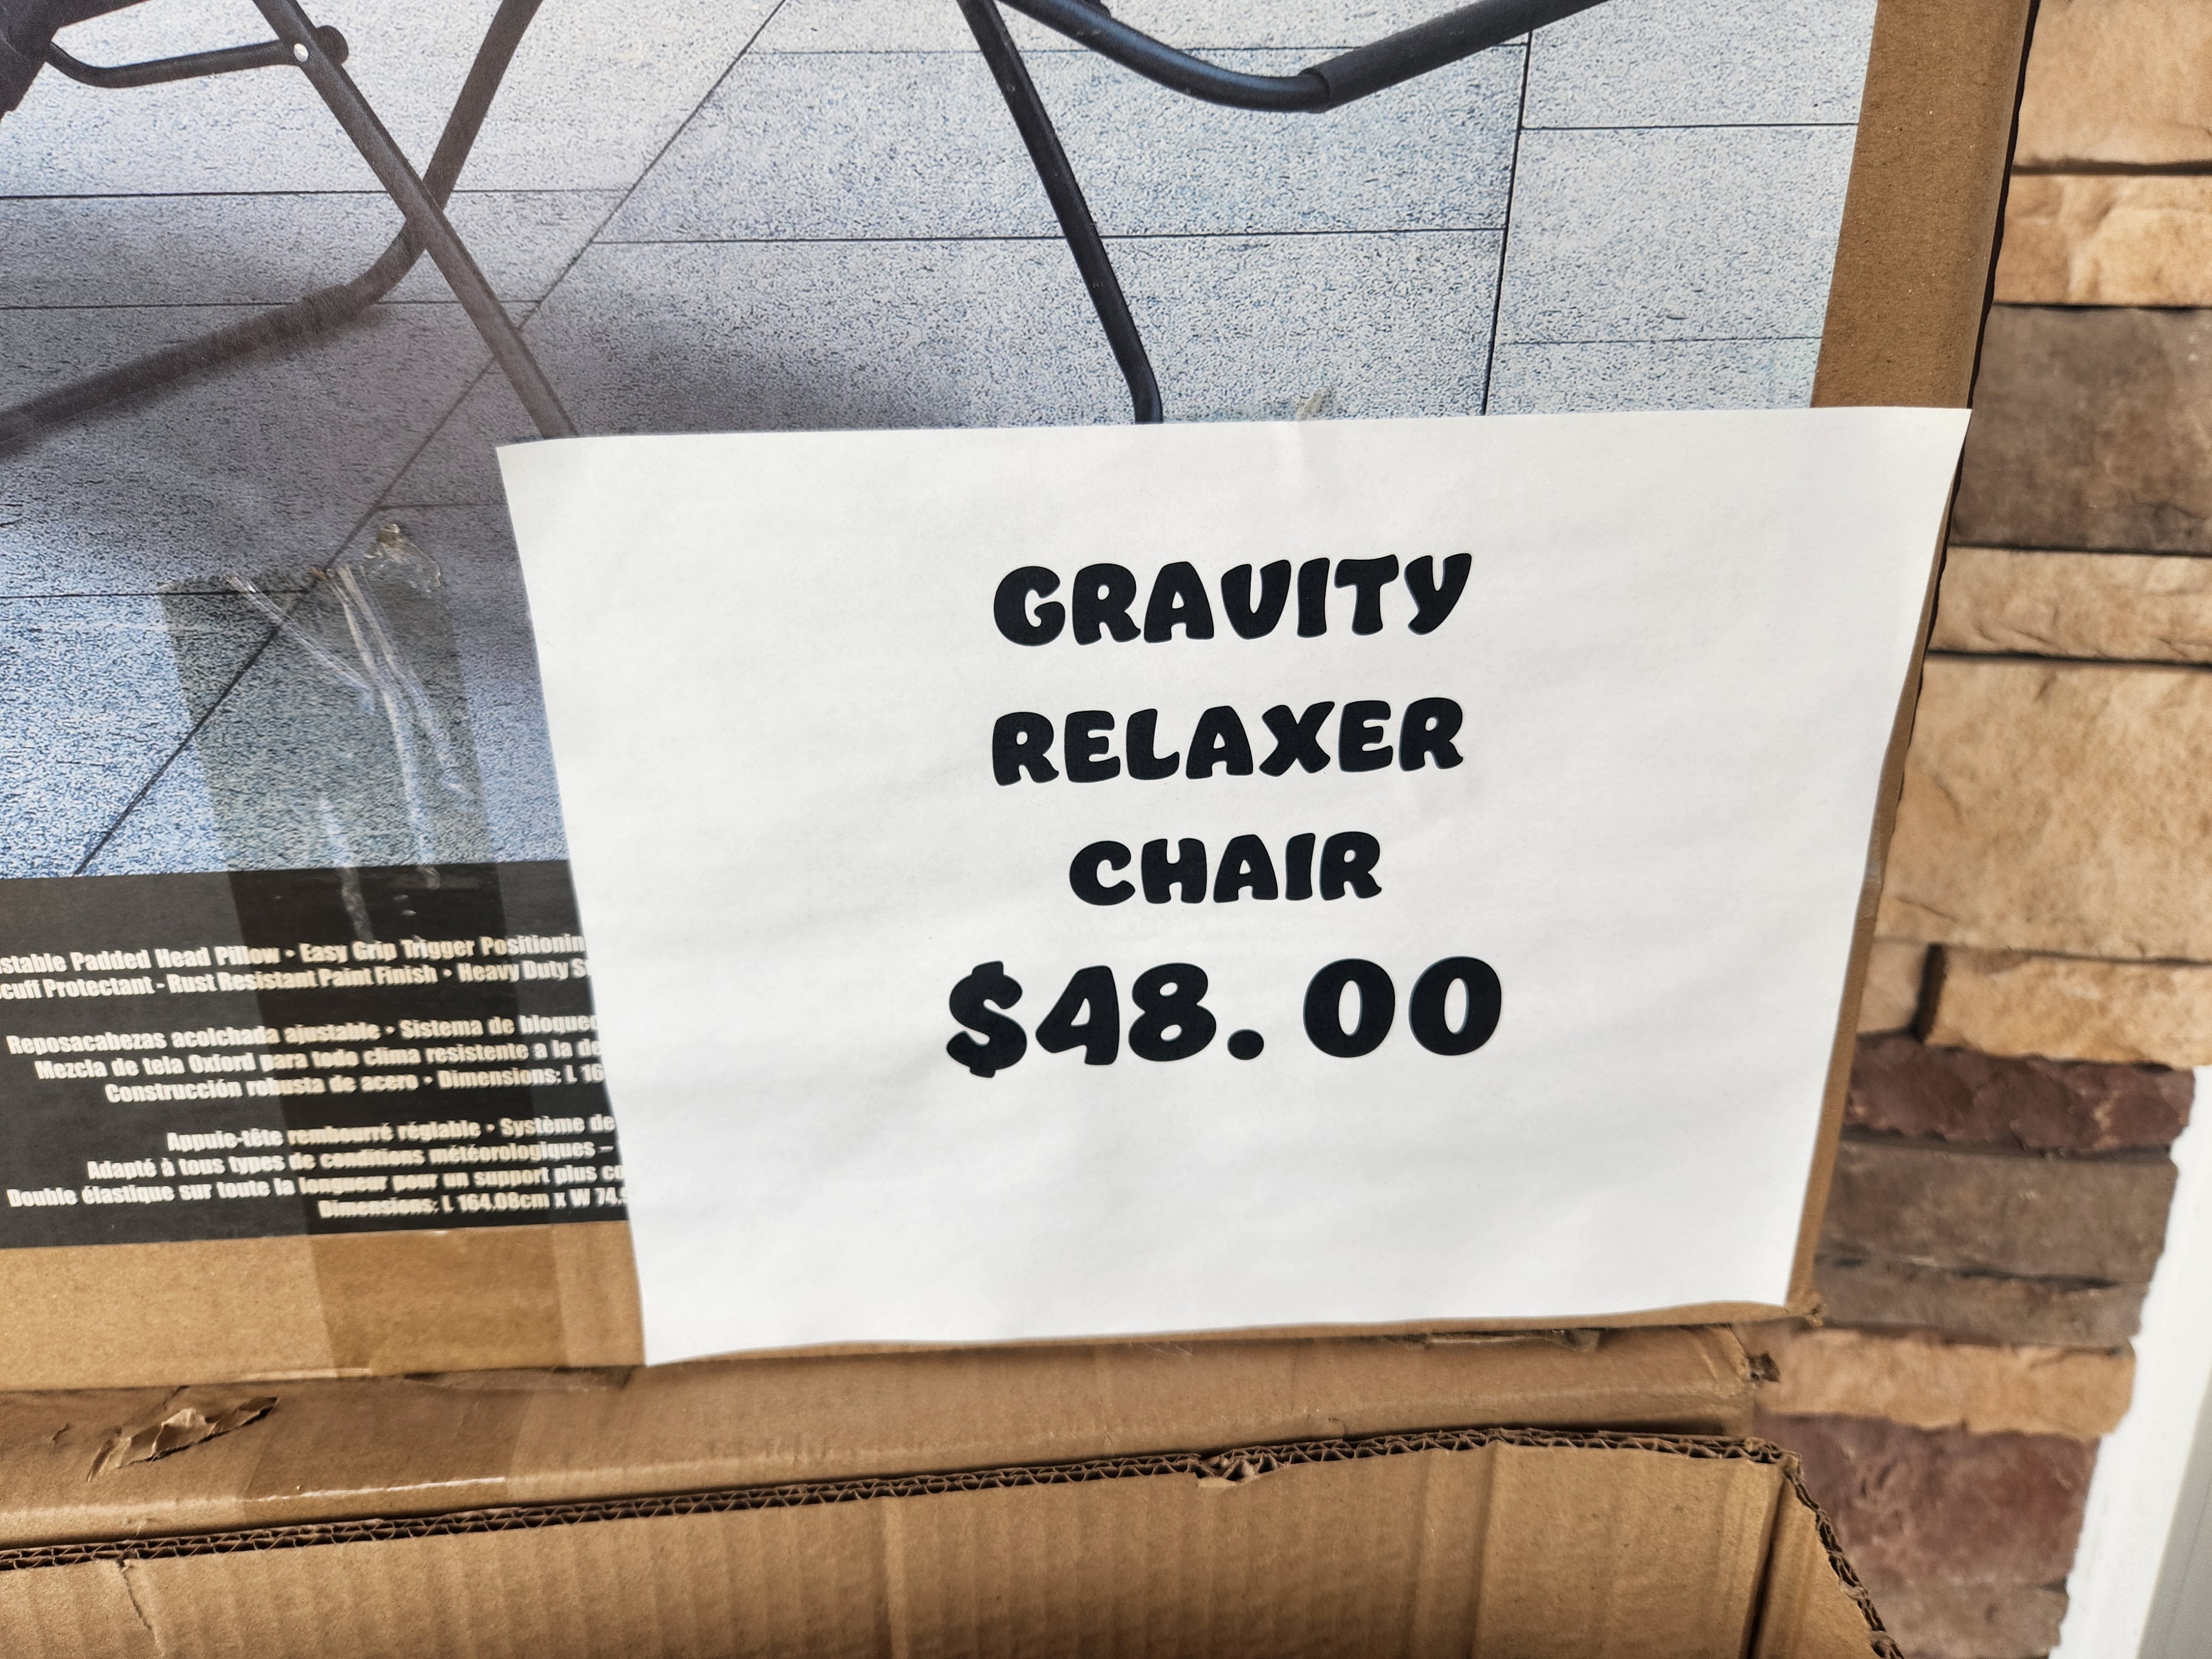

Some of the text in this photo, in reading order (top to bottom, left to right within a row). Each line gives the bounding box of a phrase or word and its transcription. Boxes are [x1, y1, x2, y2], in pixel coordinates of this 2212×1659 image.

[993, 553, 1472, 646] GRAVITY
[992, 697, 1464, 786] RELAXER
[1069, 831, 1382, 906] CHAIR
[0, 953, 67, 974] stable
[70, 949, 152, 971] Padded
[154, 947, 211, 968] Head
[214, 945, 280, 966] Pillow
[299, 942, 349, 963] Easy
[352, 940, 398, 962] Grip
[400, 938, 475, 961] Trigger
[0, 979, 43, 999] cuff
[42, 977, 155, 998] Protectant
[166, 973, 217, 994] Rust
[216, 969, 319, 992] Resistant
[317, 967, 374, 988] Paint
[373, 964, 439, 986] Finish
[456, 962, 520, 983] Heavy
[521, 960, 569, 981] Duty
[6, 1032, 167, 1055] Reposacabezas
[171, 1025, 281, 1047] acolchada
[283, 1024, 382, 1045] ajustable
[399, 1019, 484, 1039] Sistema
[487, 1016, 515, 1036] de
[34, 1058, 108, 1079] Mezcla
[111, 1057, 139, 1077] de
[142, 1056, 185, 1076] tela
[188, 1052, 257, 1074] Oxford
[259, 1052, 310, 1073] para
[311, 1048, 359, 1069] todo
[362, 1046, 422, 1067] clima
[424, 1042, 529, 1065] resistente
[533, 1042, 547, 1060] a
[551, 1039, 573, 1058] la
[105, 1077, 243, 1103] Construcción
[246, 1076, 327, 1097] robusta
[328, 1074, 357, 1094] de
[361, 1074, 420, 1093] acero
[436, 1067, 562, 1091] Dimensions:
[563, 1063, 578, 1085] L
[499, 1115, 586, 1139] Système
[588, 1113, 615, 1132] de
[87, 1157, 157, 1180] Adapté
[160, 1157, 176, 1177] à
[178, 1158, 226, 1176] tous
[228, 1155, 286, 1175] types
[288, 1151, 317, 1171] de
[427, 1141, 596, 1165] météorologiques
[6, 1187, 79, 1207] Double
[81, 1185, 176, 1204] élastique
[178, 1183, 212, 1201] sur
[216, 1180, 270, 1199] toute
[273, 1177, 296, 1197] la
[443, 1172, 470, 1190] un
[472, 1167, 552, 1188] support
[554, 1164, 598, 1187] plus
[441, 1194, 455, 1213] L
[552, 1192, 567, 1209] x
[570, 1188, 592, 1209] W
